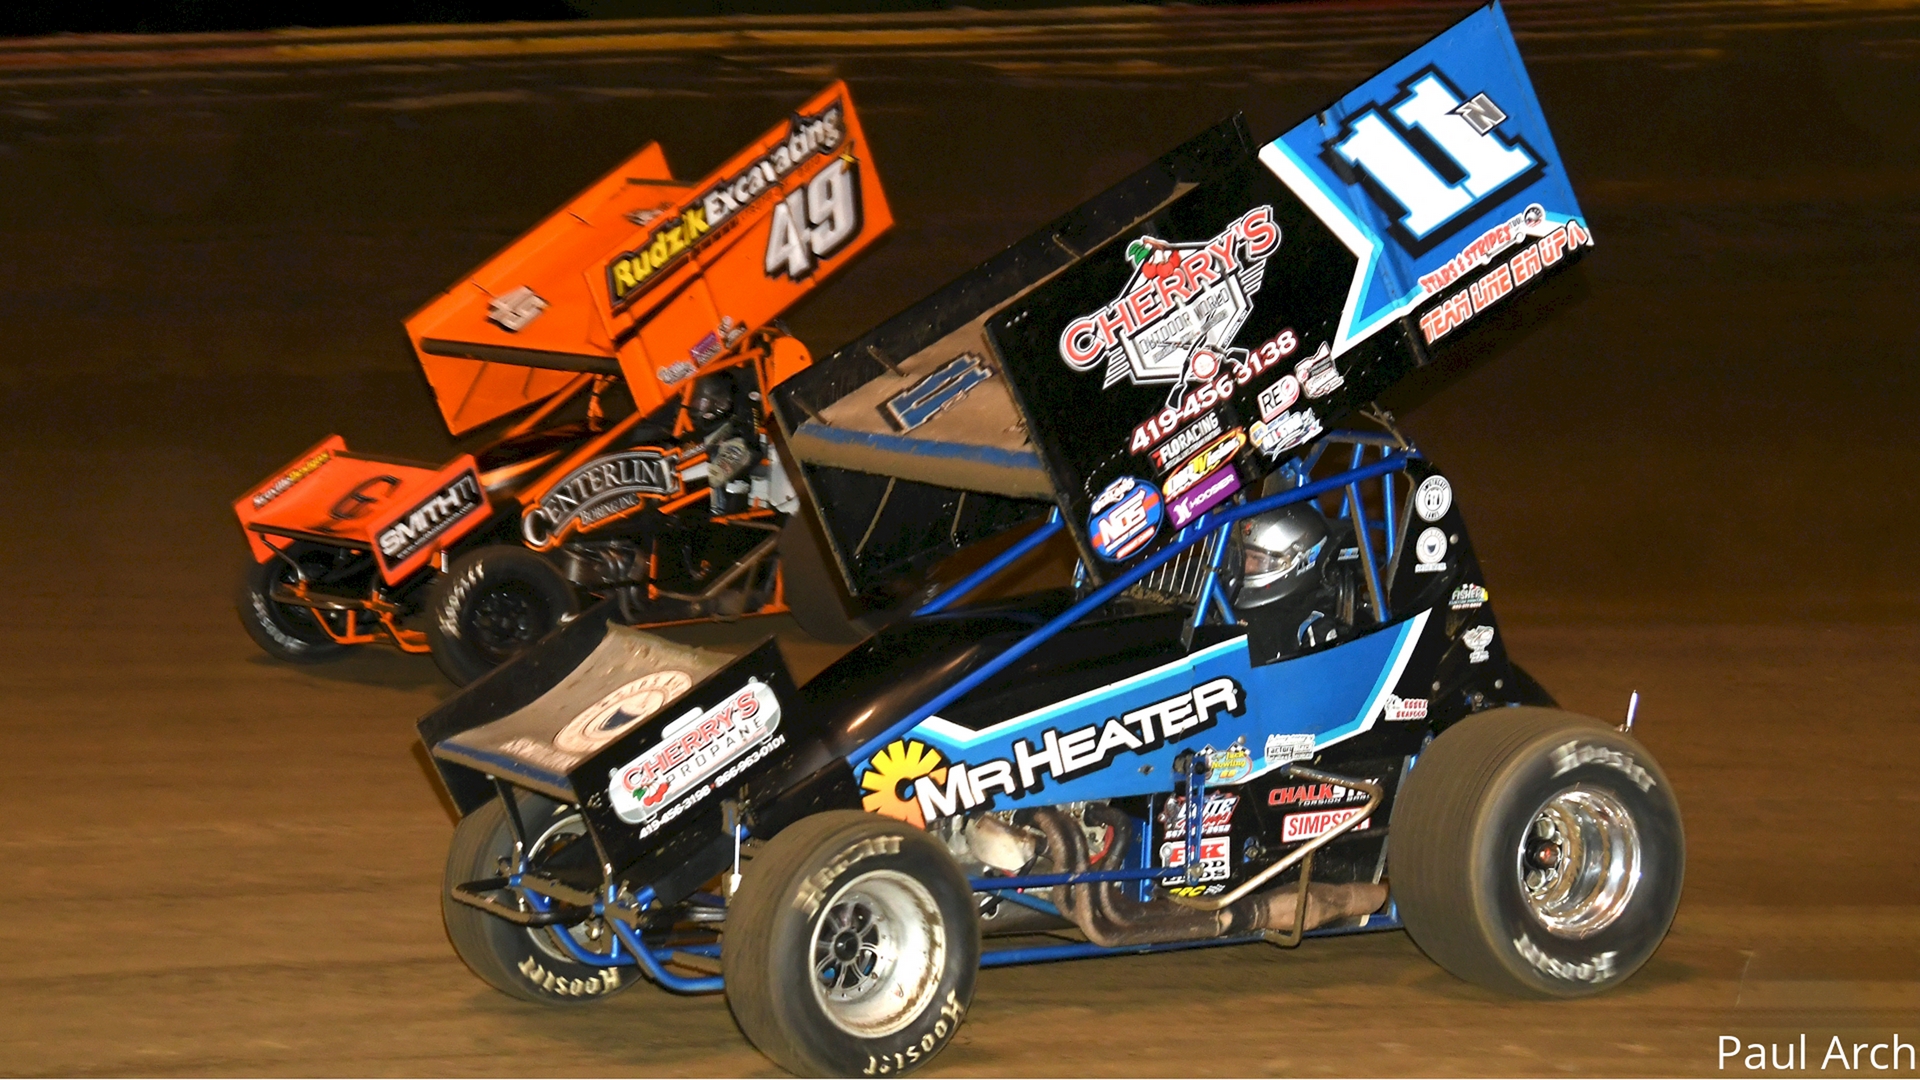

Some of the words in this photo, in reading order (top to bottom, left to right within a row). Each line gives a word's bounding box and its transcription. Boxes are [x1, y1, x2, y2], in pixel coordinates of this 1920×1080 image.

[1336, 74, 1536, 240] 11
[1454, 92, 1507, 136] N
[613, 206, 710, 297] Rudzik
[703, 107, 842, 226] Excavating
[764, 158, 860, 278] 49
[1064, 209, 1278, 366] CHERRY'S
[1420, 263, 1457, 293] STARS
[1464, 225, 1512, 267] STRIPES
[1420, 289, 1473, 345] TEAM
[1470, 263, 1514, 314] LINE
[1510, 244, 1542, 287] EM
[1139, 311, 1193, 354] OUTDOOR
[1160, 412, 1219, 464] FLORACING
[523, 454, 680, 546] CENTERLINE
[1098, 488, 1146, 547] NOS
[622, 692, 759, 792] CHERRY'S
[667, 715, 763, 785] PROPANE
[1012, 677, 1239, 789] HEATER
[863, 989, 964, 1075] Hoosier
